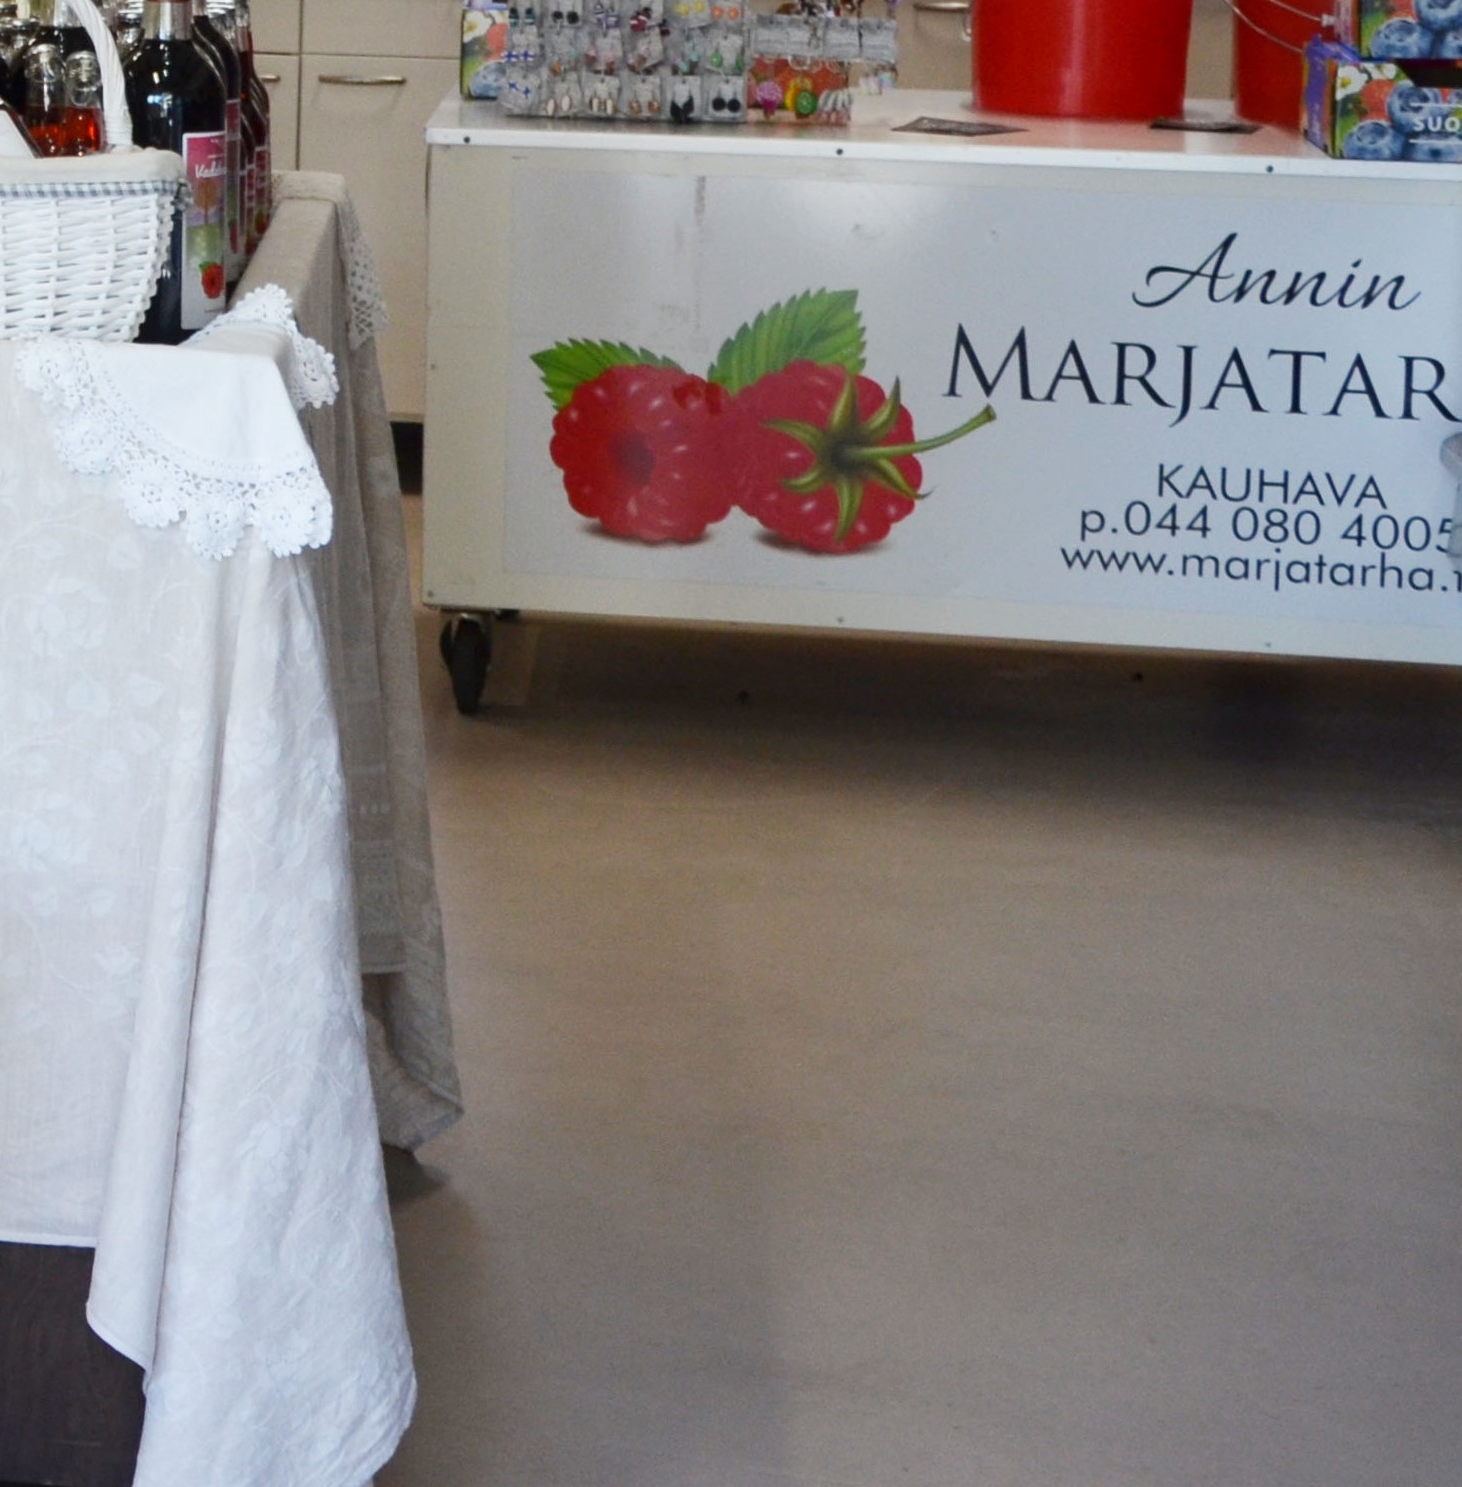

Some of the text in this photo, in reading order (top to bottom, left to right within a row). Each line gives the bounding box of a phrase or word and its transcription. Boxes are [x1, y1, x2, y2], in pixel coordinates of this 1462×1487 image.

[1132, 231, 1423, 311] Annin
[942, 322, 1462, 427] MARJATAR
[1157, 463, 1388, 510] KAUHAVA
[1079, 500, 1454, 554] p.044 080 4005
